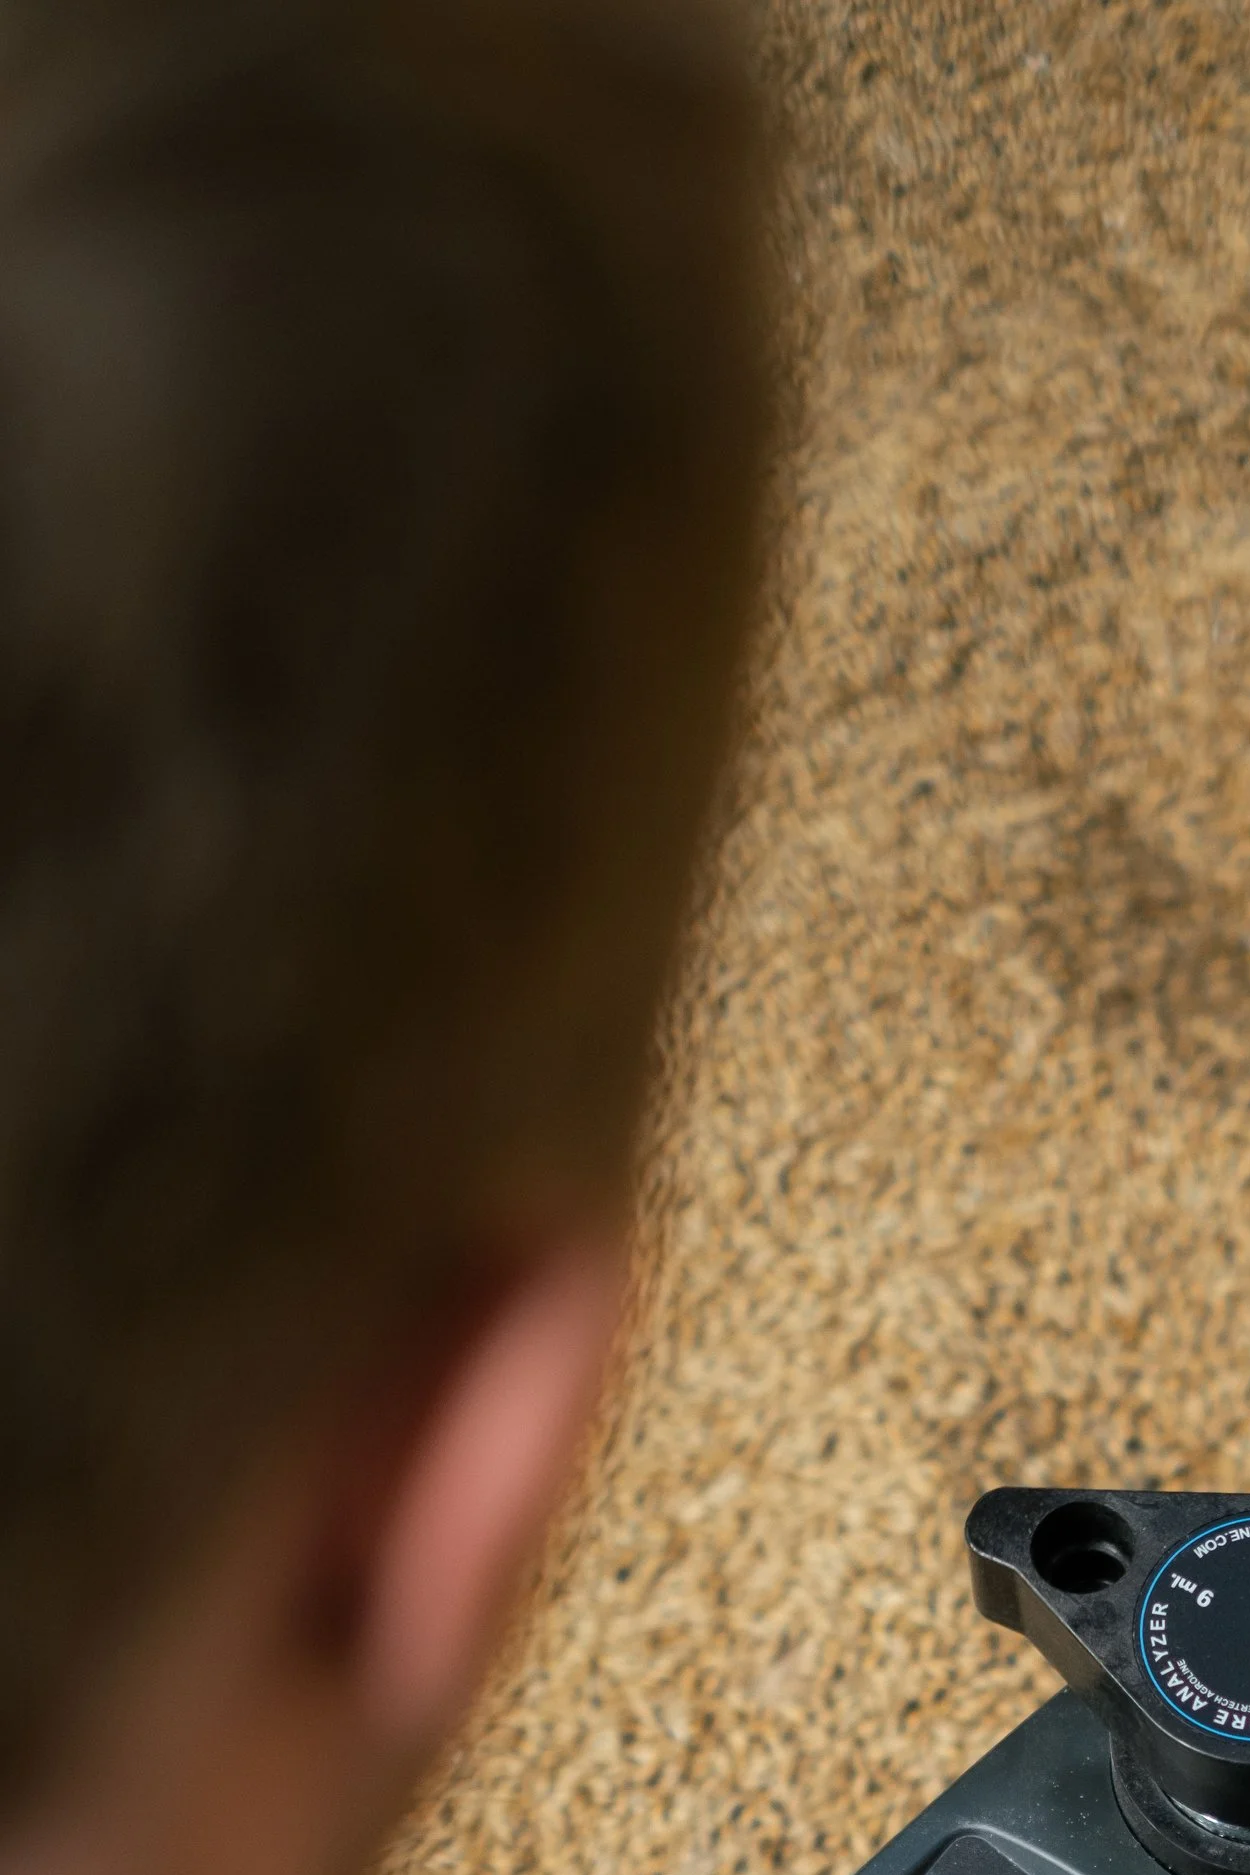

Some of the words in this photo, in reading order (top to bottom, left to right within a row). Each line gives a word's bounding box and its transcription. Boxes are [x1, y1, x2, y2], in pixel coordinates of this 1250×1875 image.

[1170, 1573, 1198, 1594] ml.
[1196, 1589, 1215, 1608] 9
[1150, 1602, 1208, 1711] ANALYZER
[1176, 1658, 1217, 1698] AGROLINE
